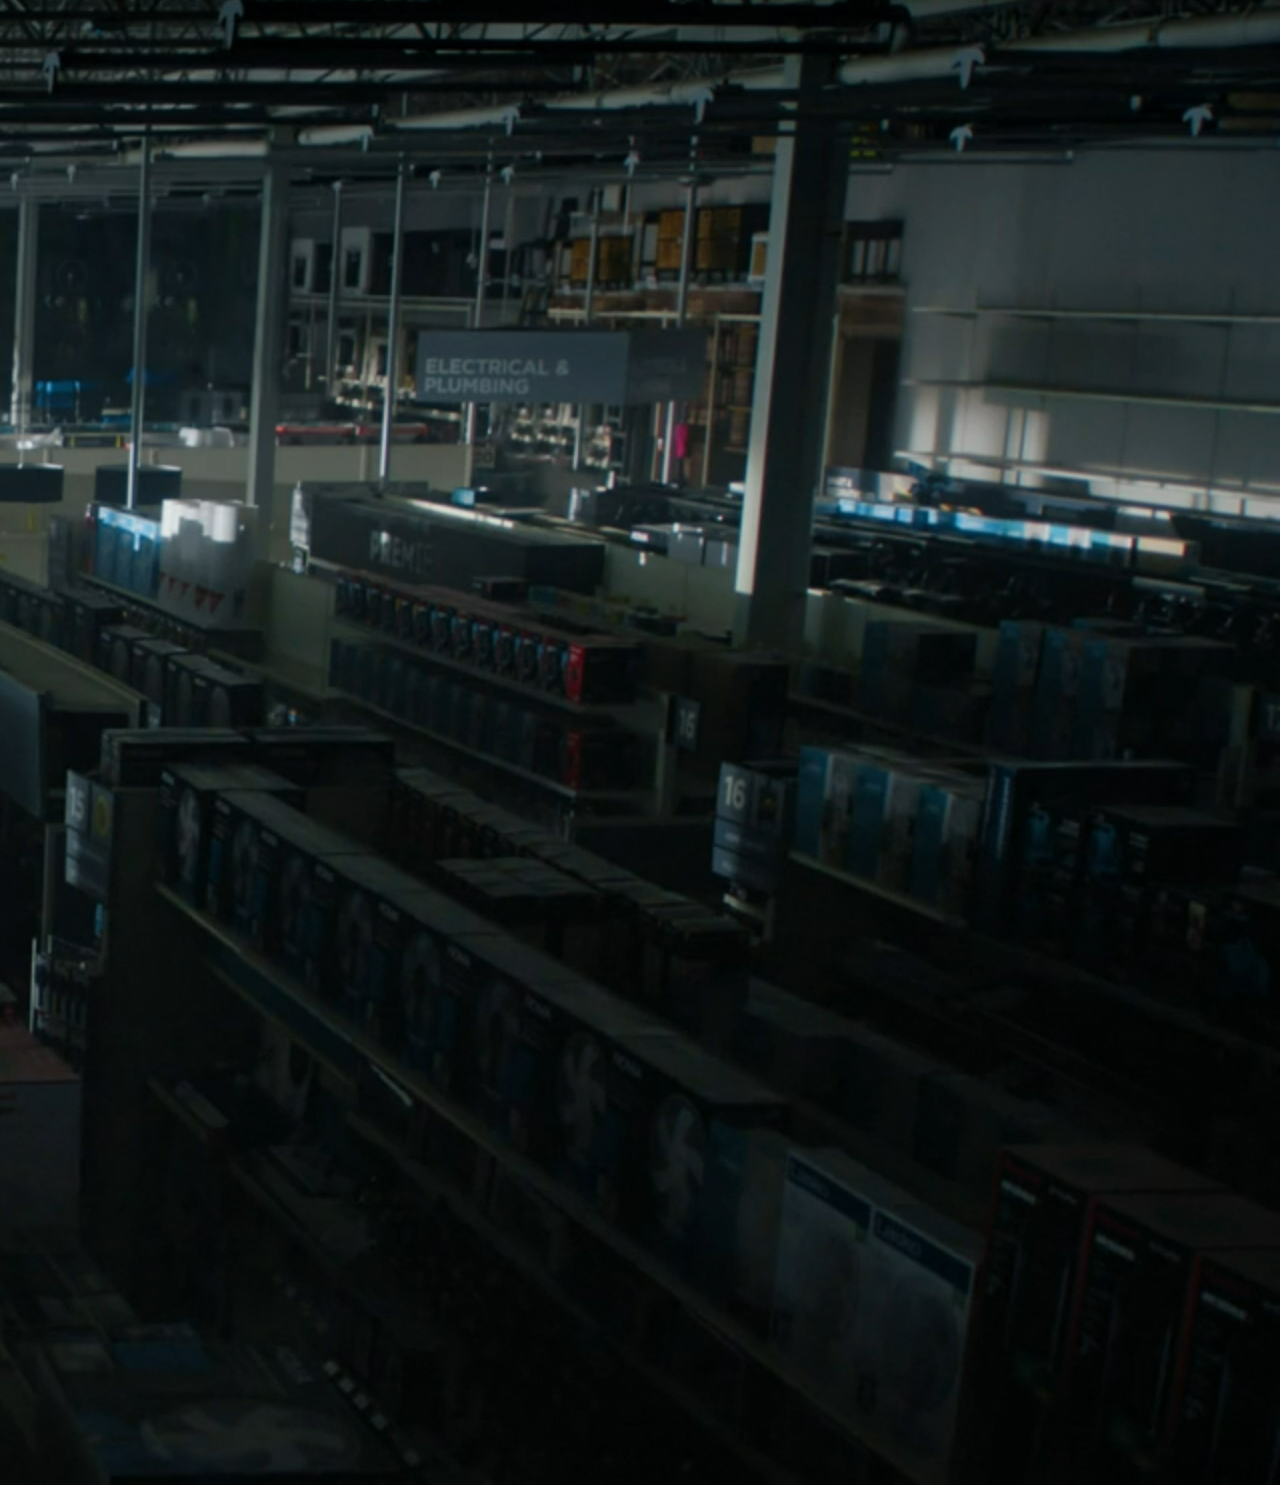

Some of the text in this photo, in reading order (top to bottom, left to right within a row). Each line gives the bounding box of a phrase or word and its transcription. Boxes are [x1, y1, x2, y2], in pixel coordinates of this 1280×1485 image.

[424, 358, 570, 376] ELECTRICAL &
[424, 377, 530, 395] PLUMBING
[370, 531, 438, 575] PREMIE
[70, 787, 86, 822] 15
[724, 775, 746, 810] 16
